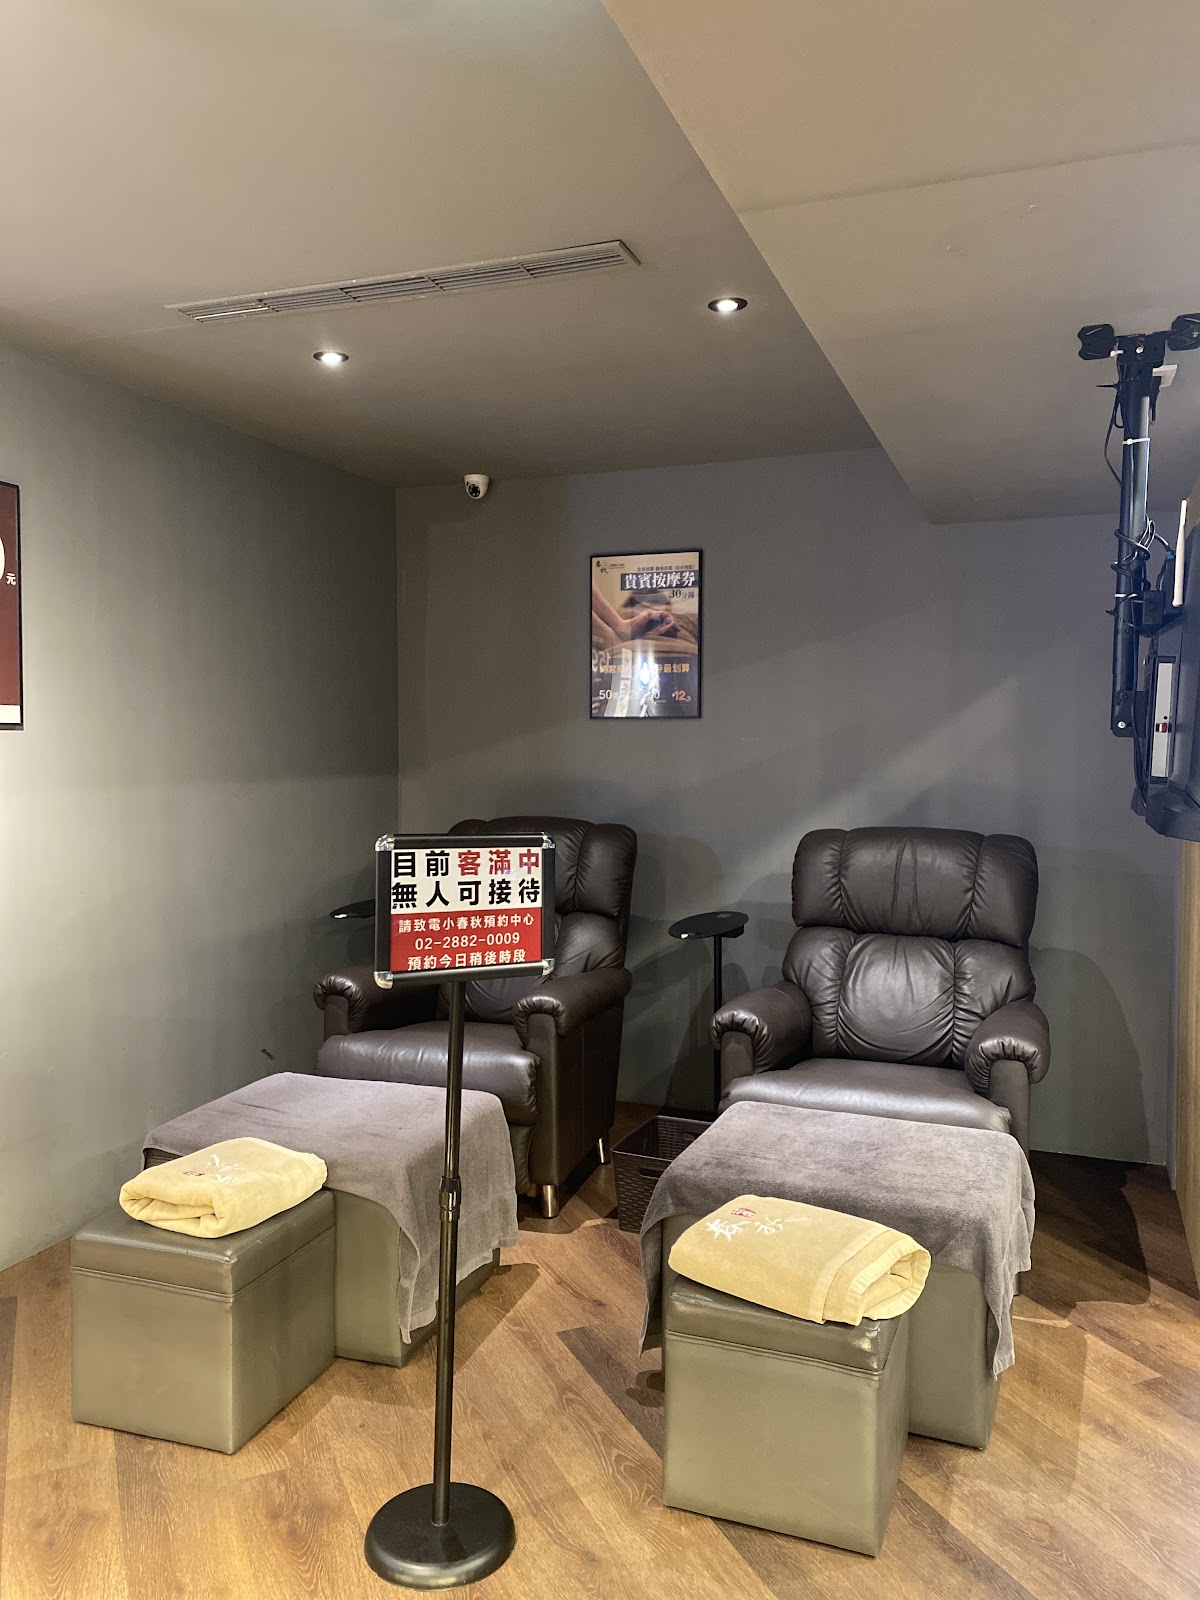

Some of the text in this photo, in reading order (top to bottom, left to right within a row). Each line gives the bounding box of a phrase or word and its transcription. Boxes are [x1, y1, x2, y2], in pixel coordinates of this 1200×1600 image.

[6, 572, 17, 586] 元
[393, 848, 541, 878] 目前客滿中
[391, 878, 541, 910] 無人可接待
[398, 913, 535, 934] 請致電小春秋預約中心
[415, 932, 521, 951] 02-2882-0009
[407, 949, 526, 971] 預約今日稍後時段
